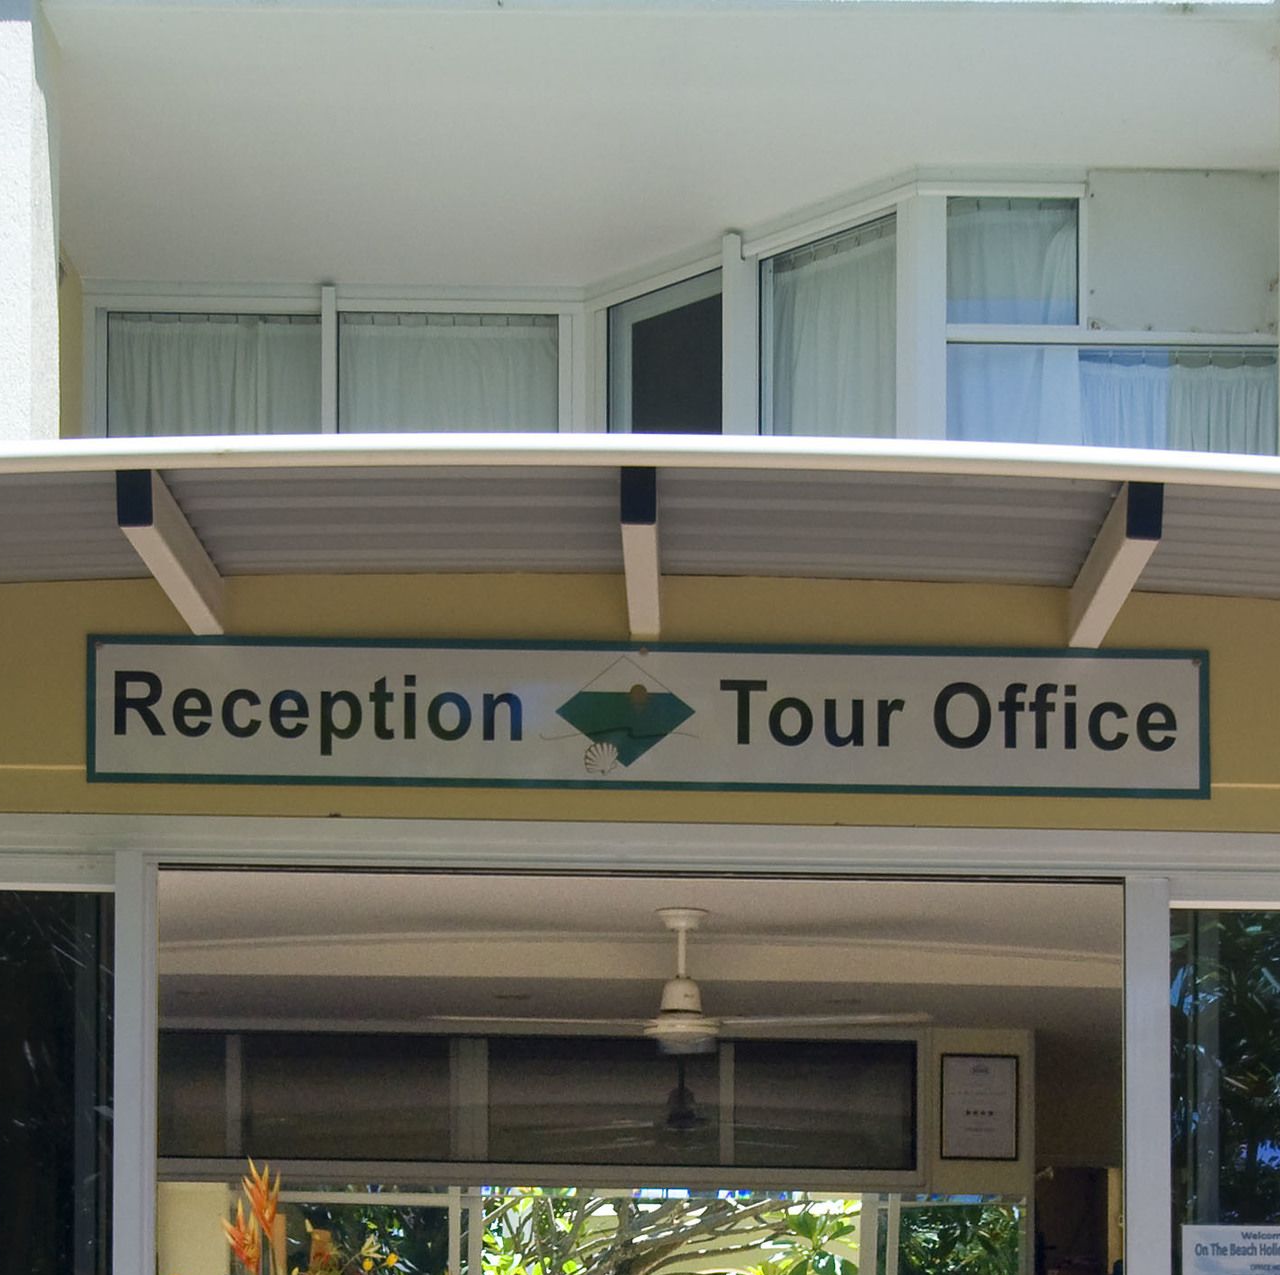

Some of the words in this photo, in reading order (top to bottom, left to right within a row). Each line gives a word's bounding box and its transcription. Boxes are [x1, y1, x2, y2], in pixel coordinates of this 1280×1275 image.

[113, 669, 524, 756] Reception
[720, 679, 906, 749] Tour
[933, 681, 1178, 752] Office
[1194, 1243, 1209, 1256] On
[1210, 1243, 1228, 1256] The
[1230, 1242, 1258, 1256] Beach
